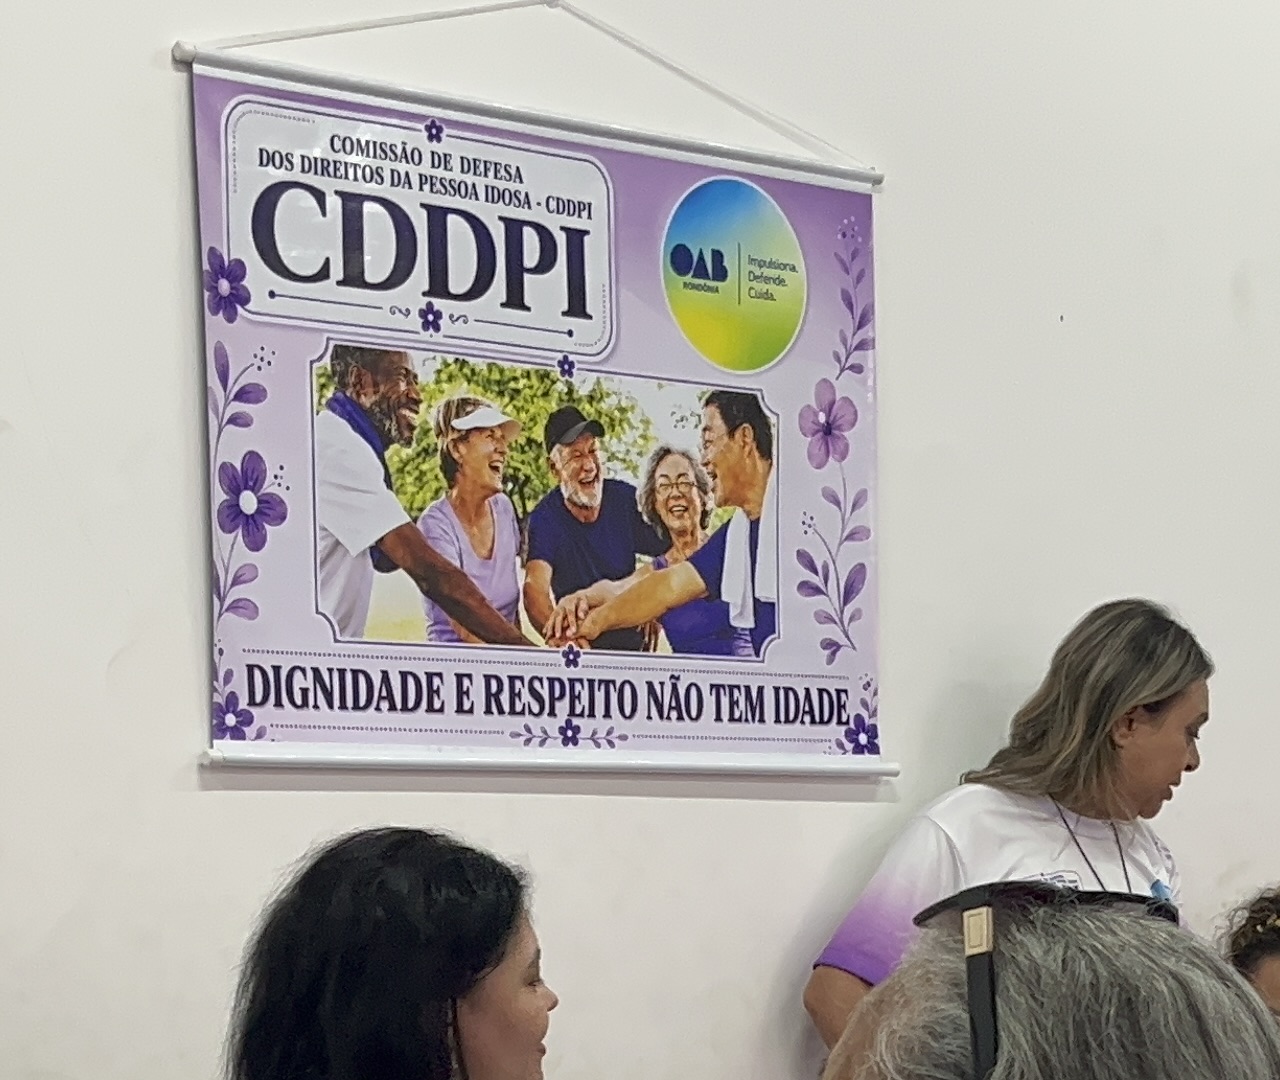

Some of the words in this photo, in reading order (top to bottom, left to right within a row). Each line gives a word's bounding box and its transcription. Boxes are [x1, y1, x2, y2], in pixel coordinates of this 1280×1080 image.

[258, 147, 294, 172] DOS
[300, 154, 384, 186] DIREITOS
[390, 167, 413, 191] DA
[418, 172, 479, 201] PESSOA
[484, 184, 532, 210] IDOSA
[545, 195, 593, 221] CDDPI
[330, 134, 421, 166] COMISSÃO
[431, 150, 452, 172] DE
[460, 155, 524, 185] DEFESA
[251, 180, 593, 320] CDDPI
[670, 243, 728, 282] OAB
[245, 663, 445, 713] DIGNIDADE
[453, 672, 474, 714] E
[482, 673, 638, 720] RESPEITO
[645, 674, 704, 721] NÃO
[710, 683, 766, 723] TEM
[773, 686, 850, 726] IDADE
